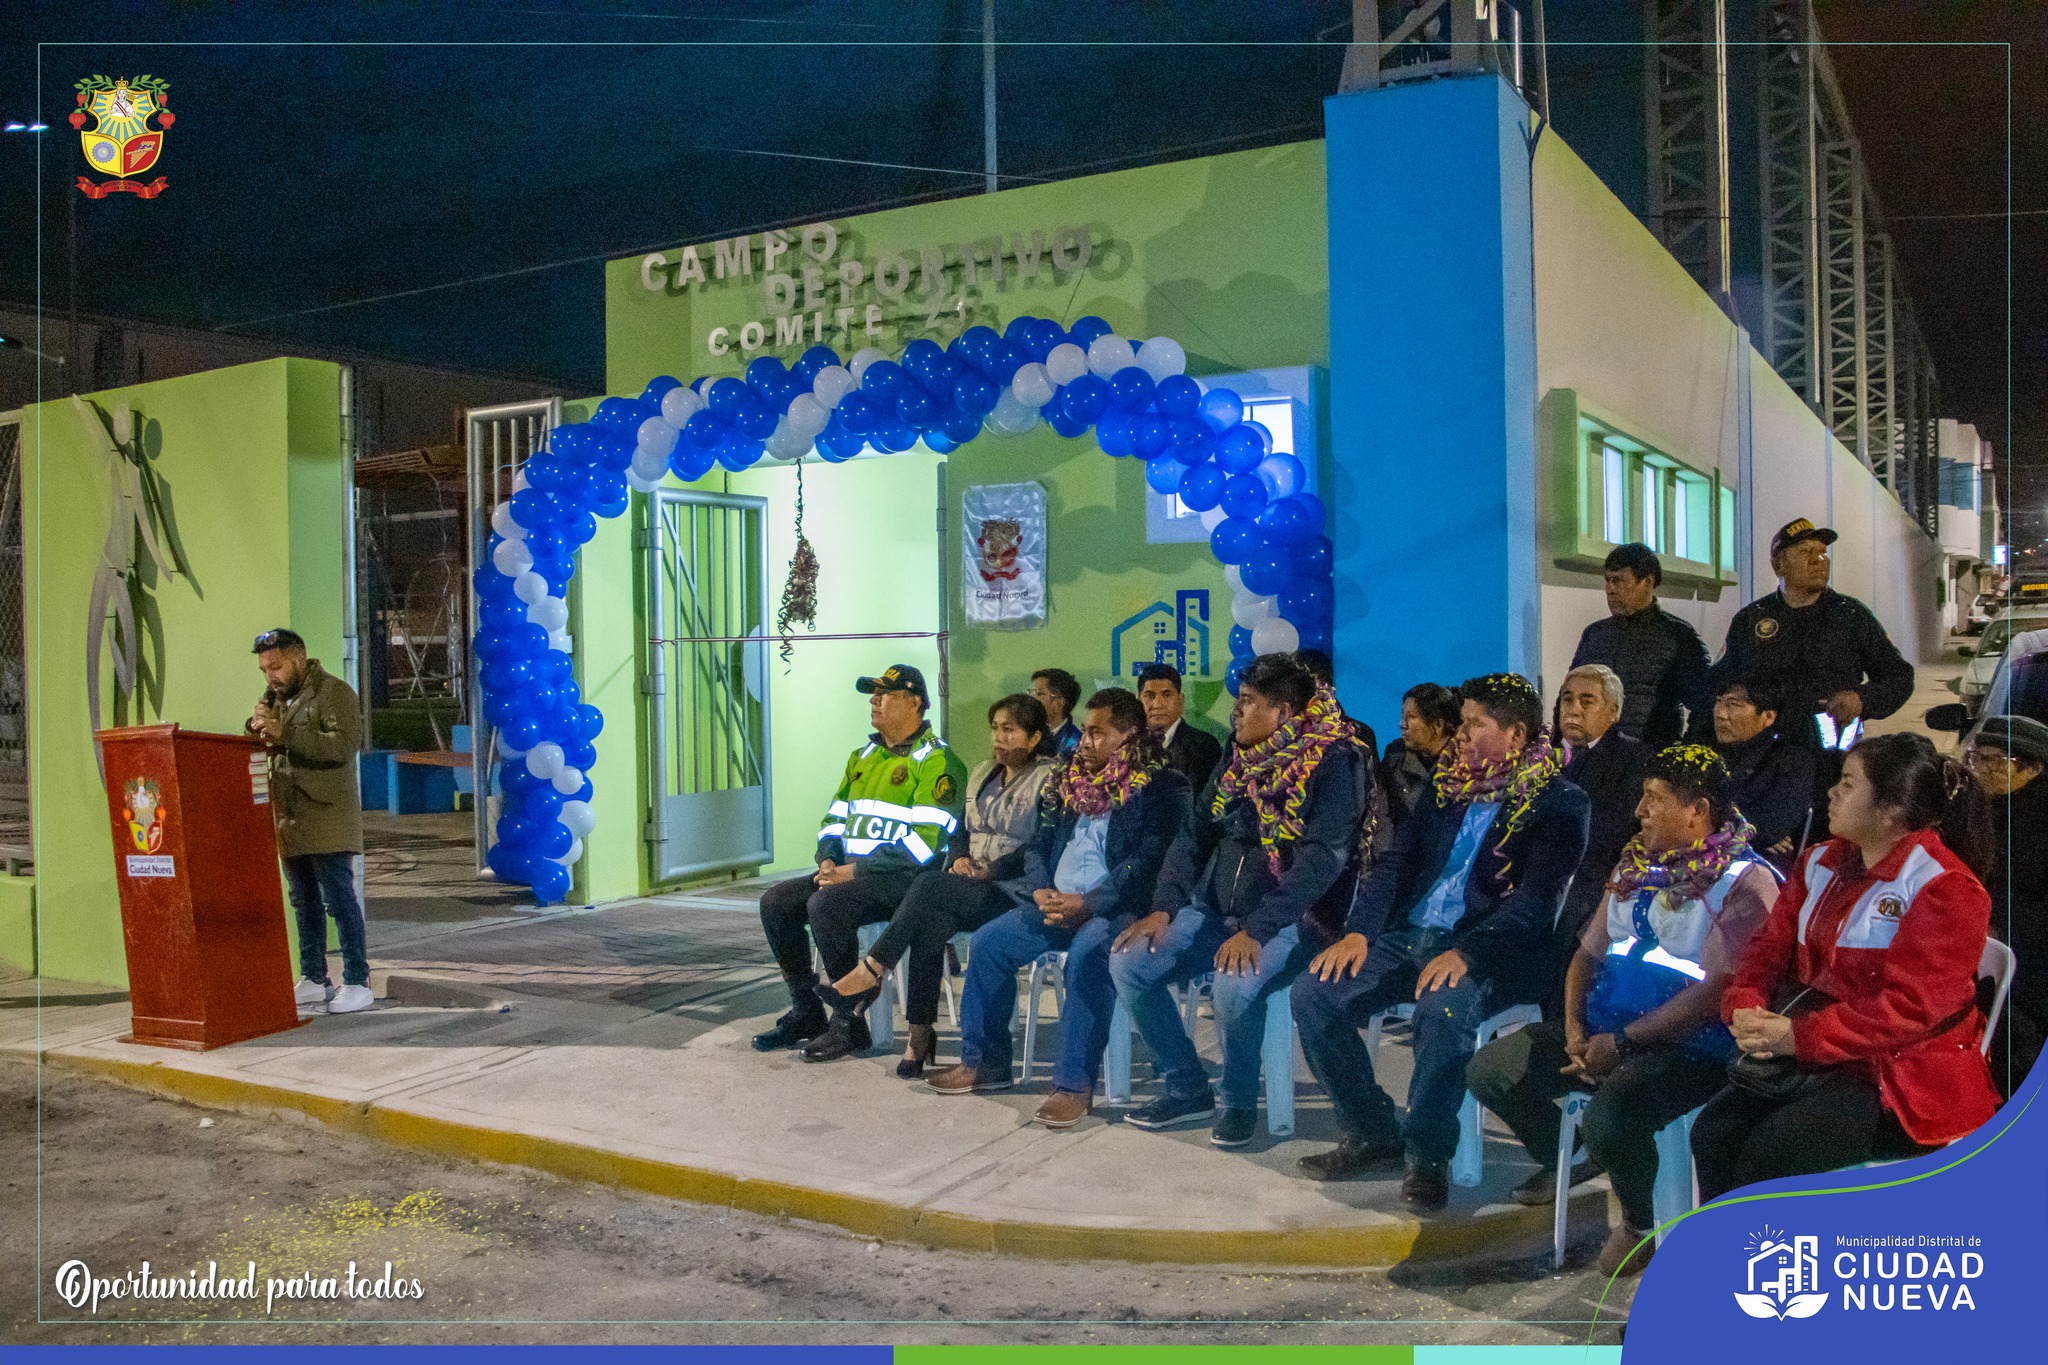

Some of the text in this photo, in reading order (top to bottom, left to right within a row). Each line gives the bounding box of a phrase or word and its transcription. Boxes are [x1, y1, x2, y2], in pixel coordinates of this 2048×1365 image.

[641, 222, 838, 291] CAMPO
[766, 226, 1093, 316] DEPORTIVO
[708, 304, 883, 356] COMITE
[846, 816, 908, 841] ICIA
[130, 864, 172, 874] Ciudad Nueva
